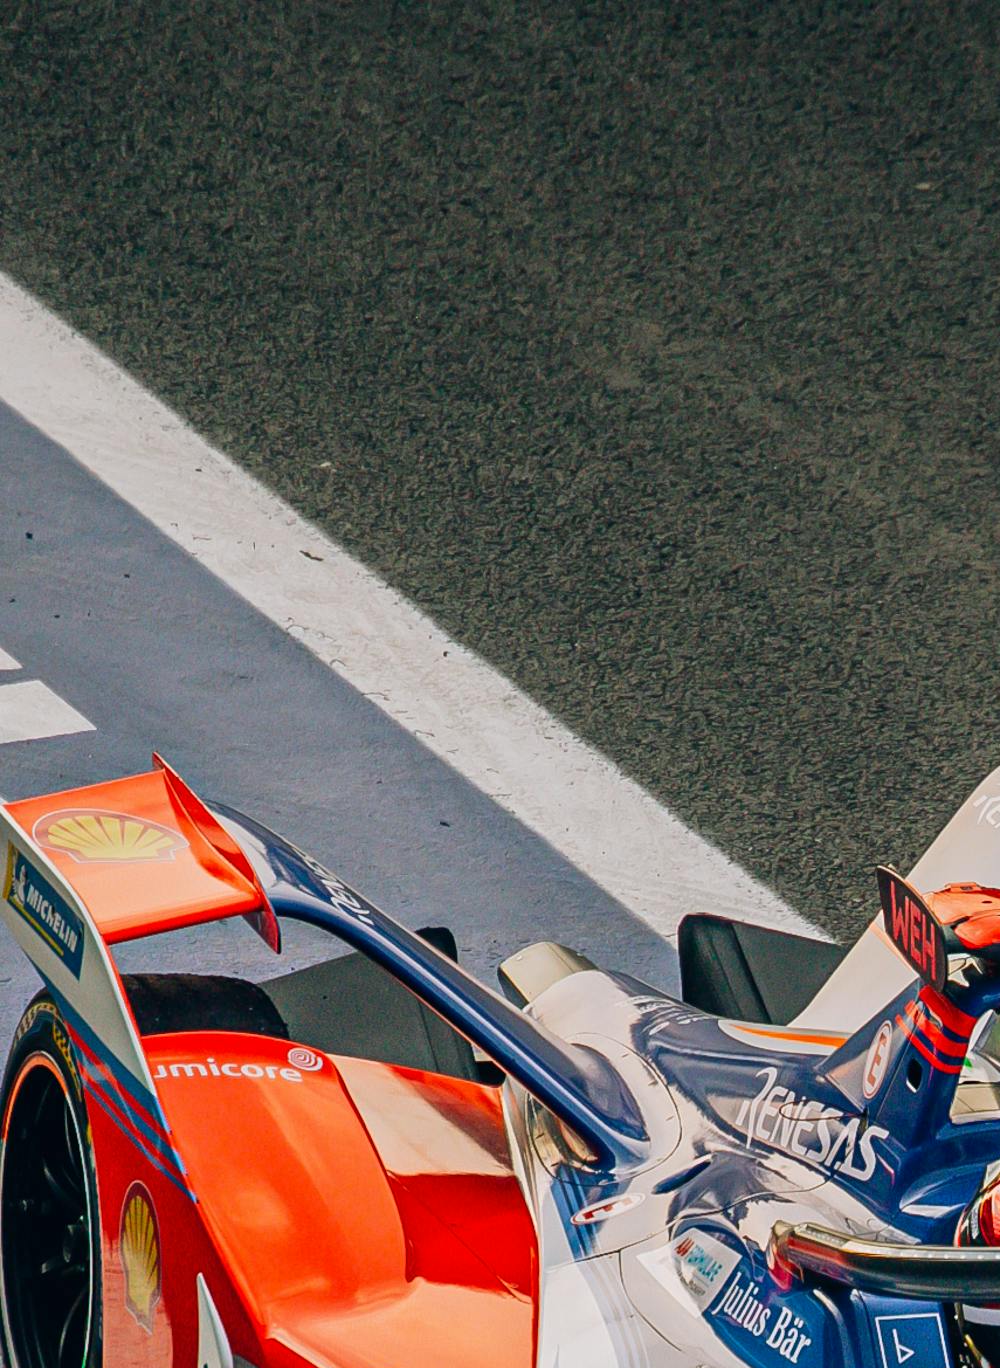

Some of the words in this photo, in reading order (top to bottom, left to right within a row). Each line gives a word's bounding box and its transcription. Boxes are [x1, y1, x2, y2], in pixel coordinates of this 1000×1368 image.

[26, 883, 78, 953] MICHELIN
[890, 879, 938, 981] WEH
[736, 1067, 889, 1182] RENESAS
[711, 1271, 770, 1340] Julius
[766, 1313, 811, 1365] Bär
